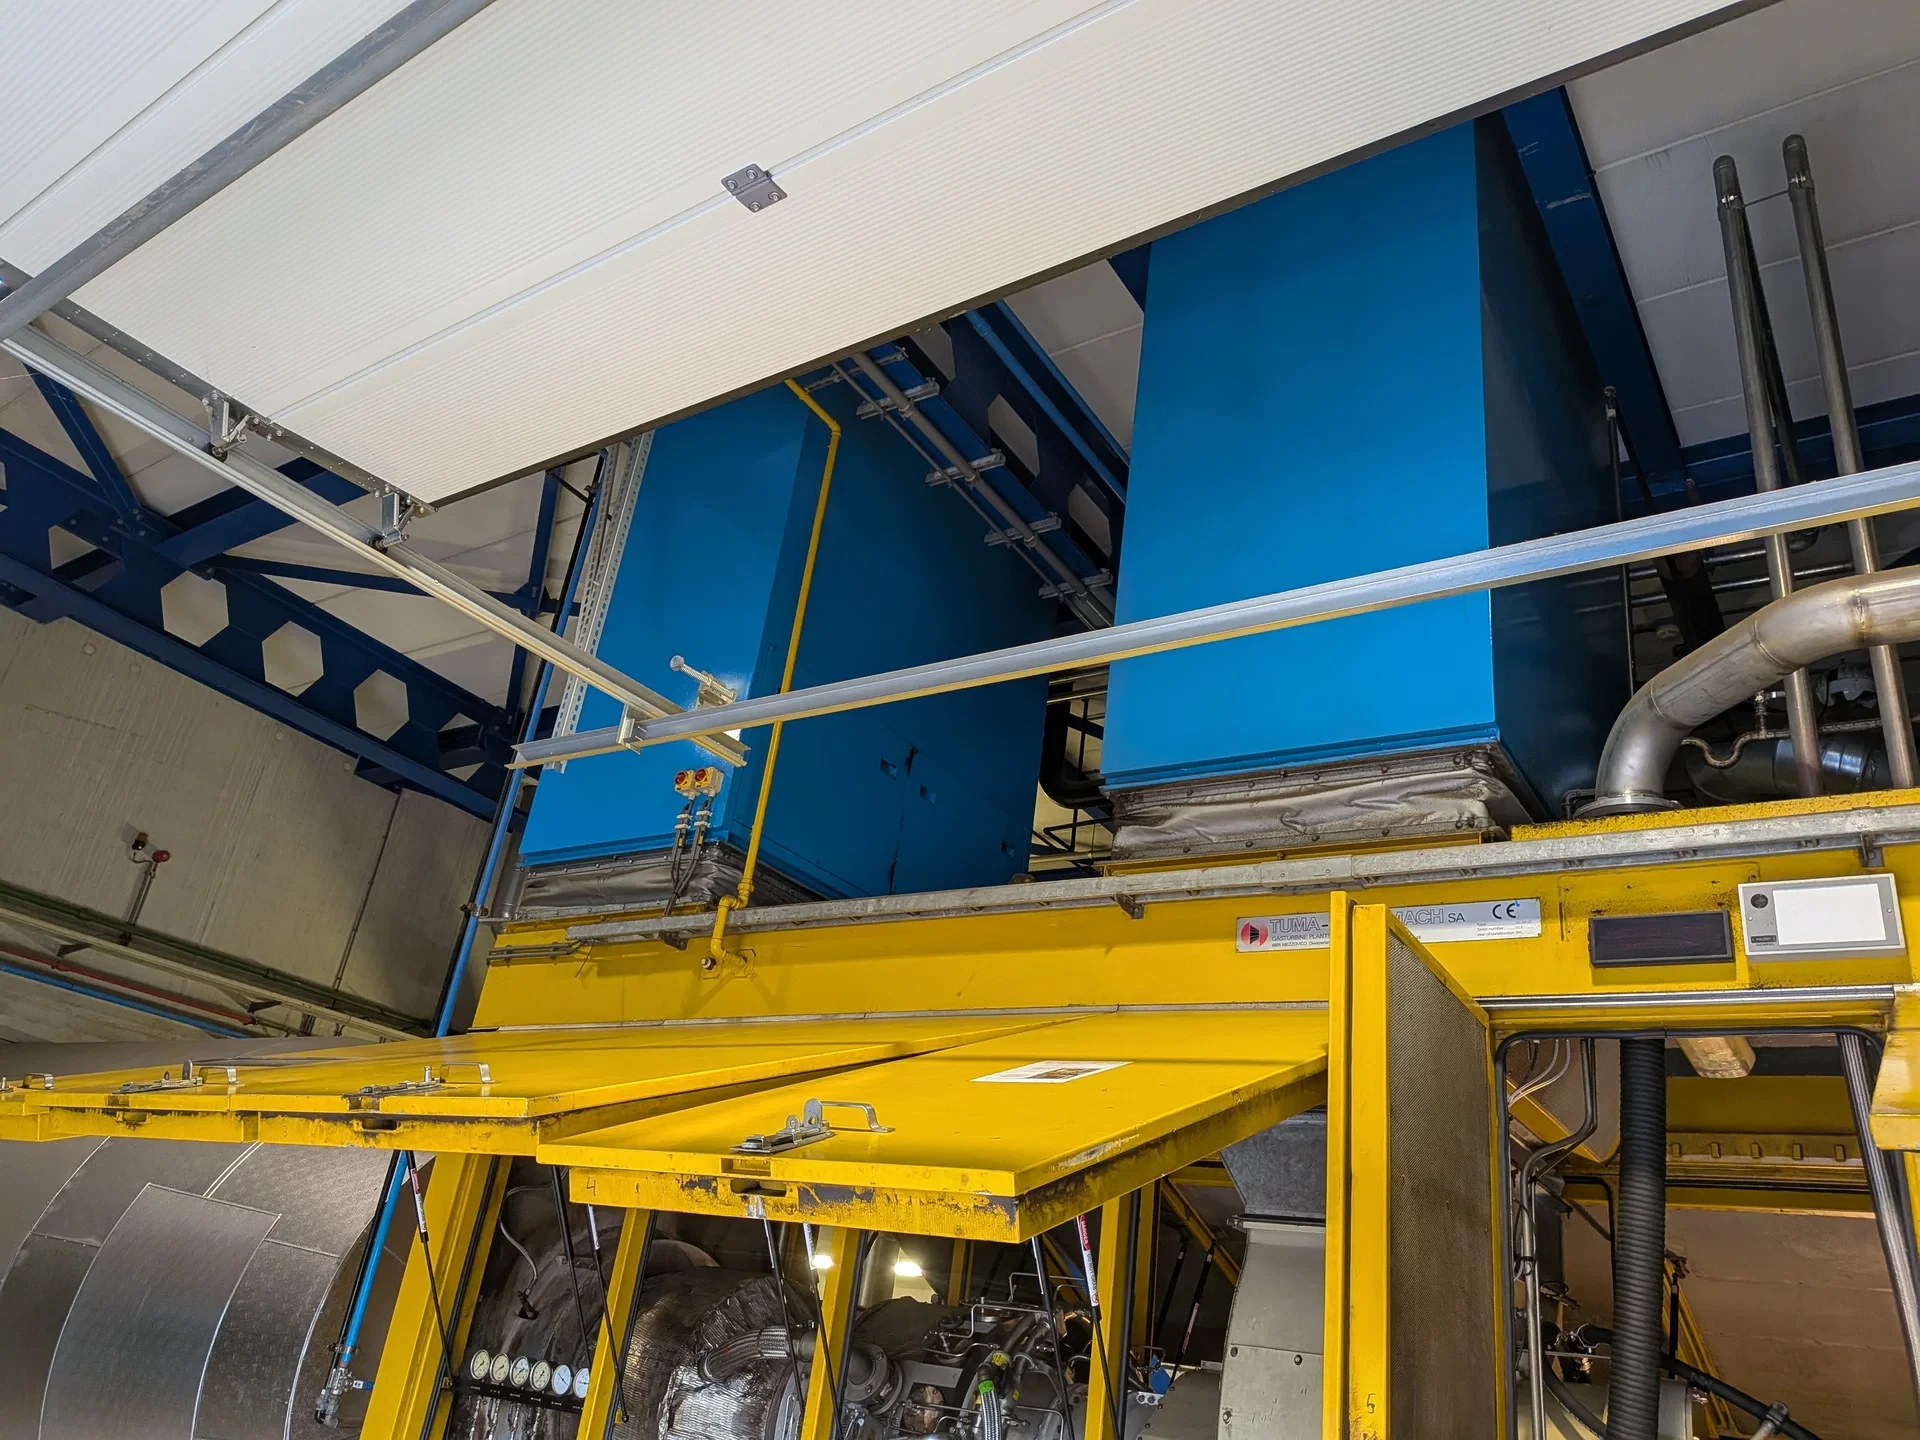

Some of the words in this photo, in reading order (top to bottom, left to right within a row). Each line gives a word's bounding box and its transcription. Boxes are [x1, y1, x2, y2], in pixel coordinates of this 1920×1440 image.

[1448, 913, 1465, 923] SA
[1492, 903, 1516, 919] CE
[586, 1176, 596, 1197] 4
[1081, 1220, 1089, 1244] DANGER
